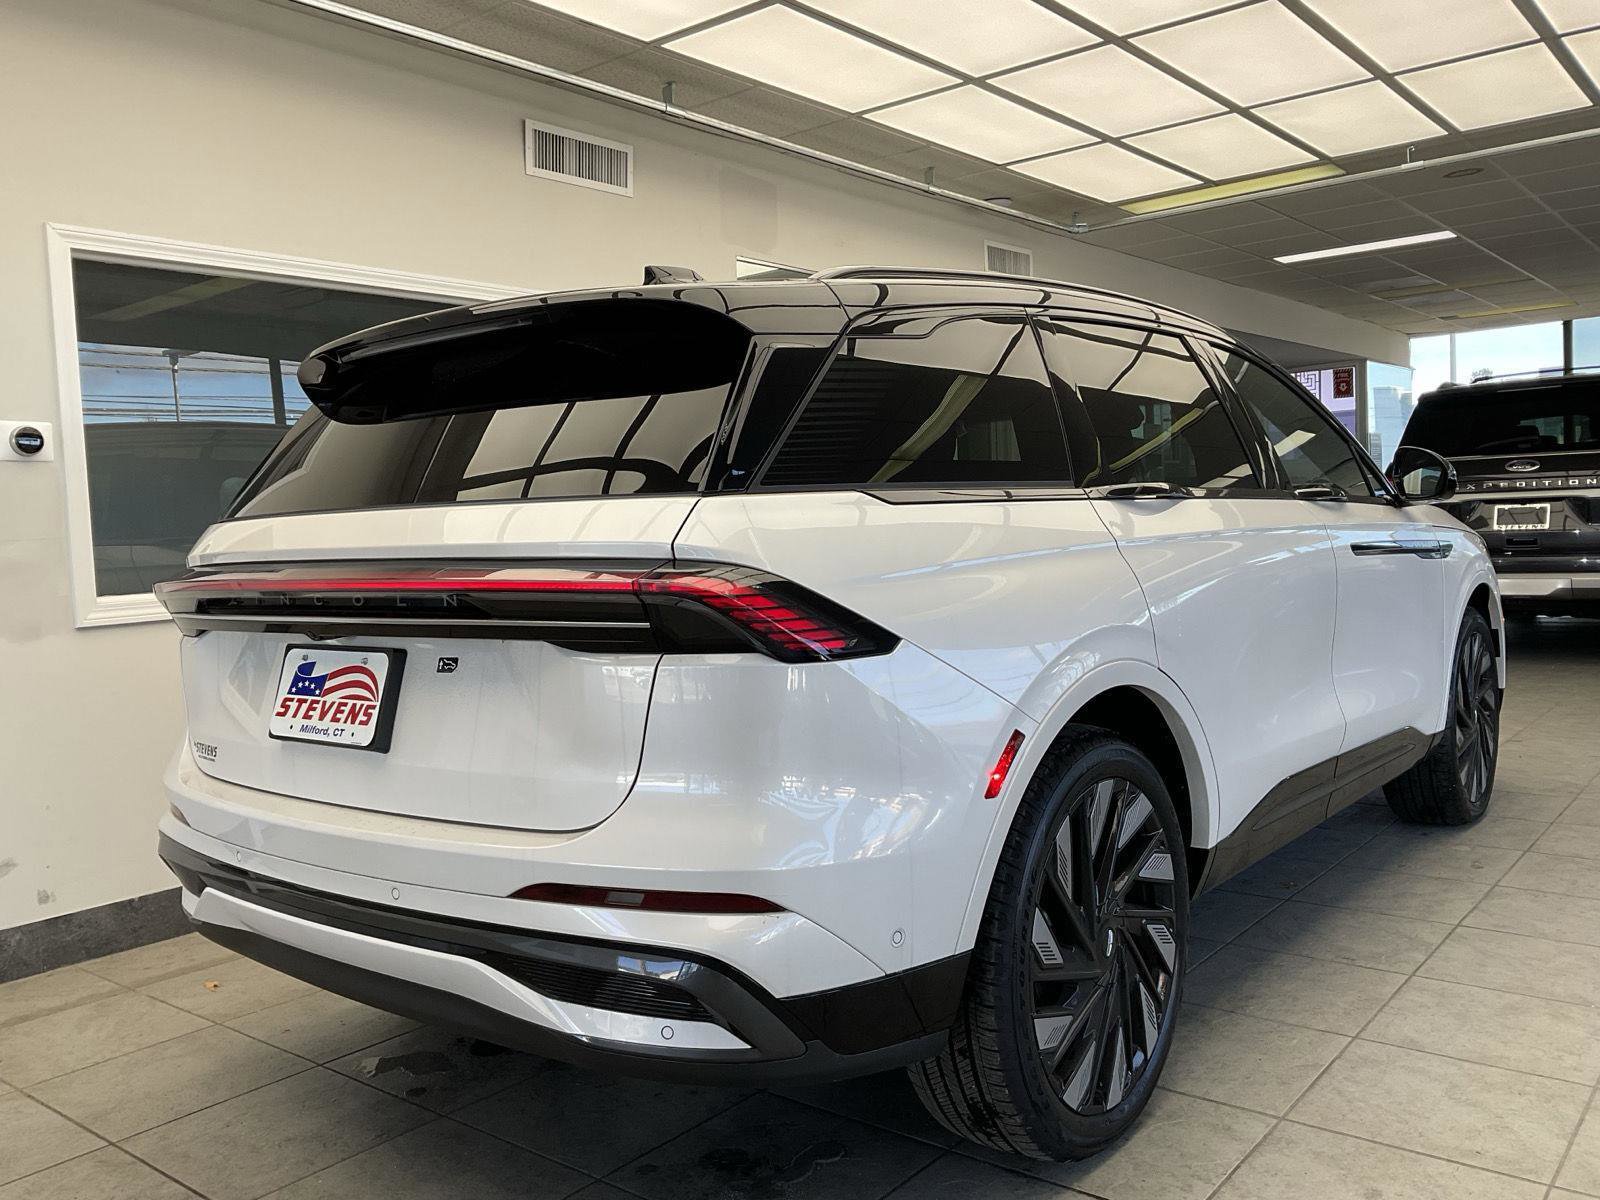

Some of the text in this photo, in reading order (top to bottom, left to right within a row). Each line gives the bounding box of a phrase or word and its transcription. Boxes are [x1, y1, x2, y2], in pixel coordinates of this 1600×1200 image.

[1456, 478, 1597, 490] XPEDITION
[275, 696, 378, 726] STEVENS
[299, 724, 345, 738] Milford, CT
[196, 741, 218, 758] STEVENS
